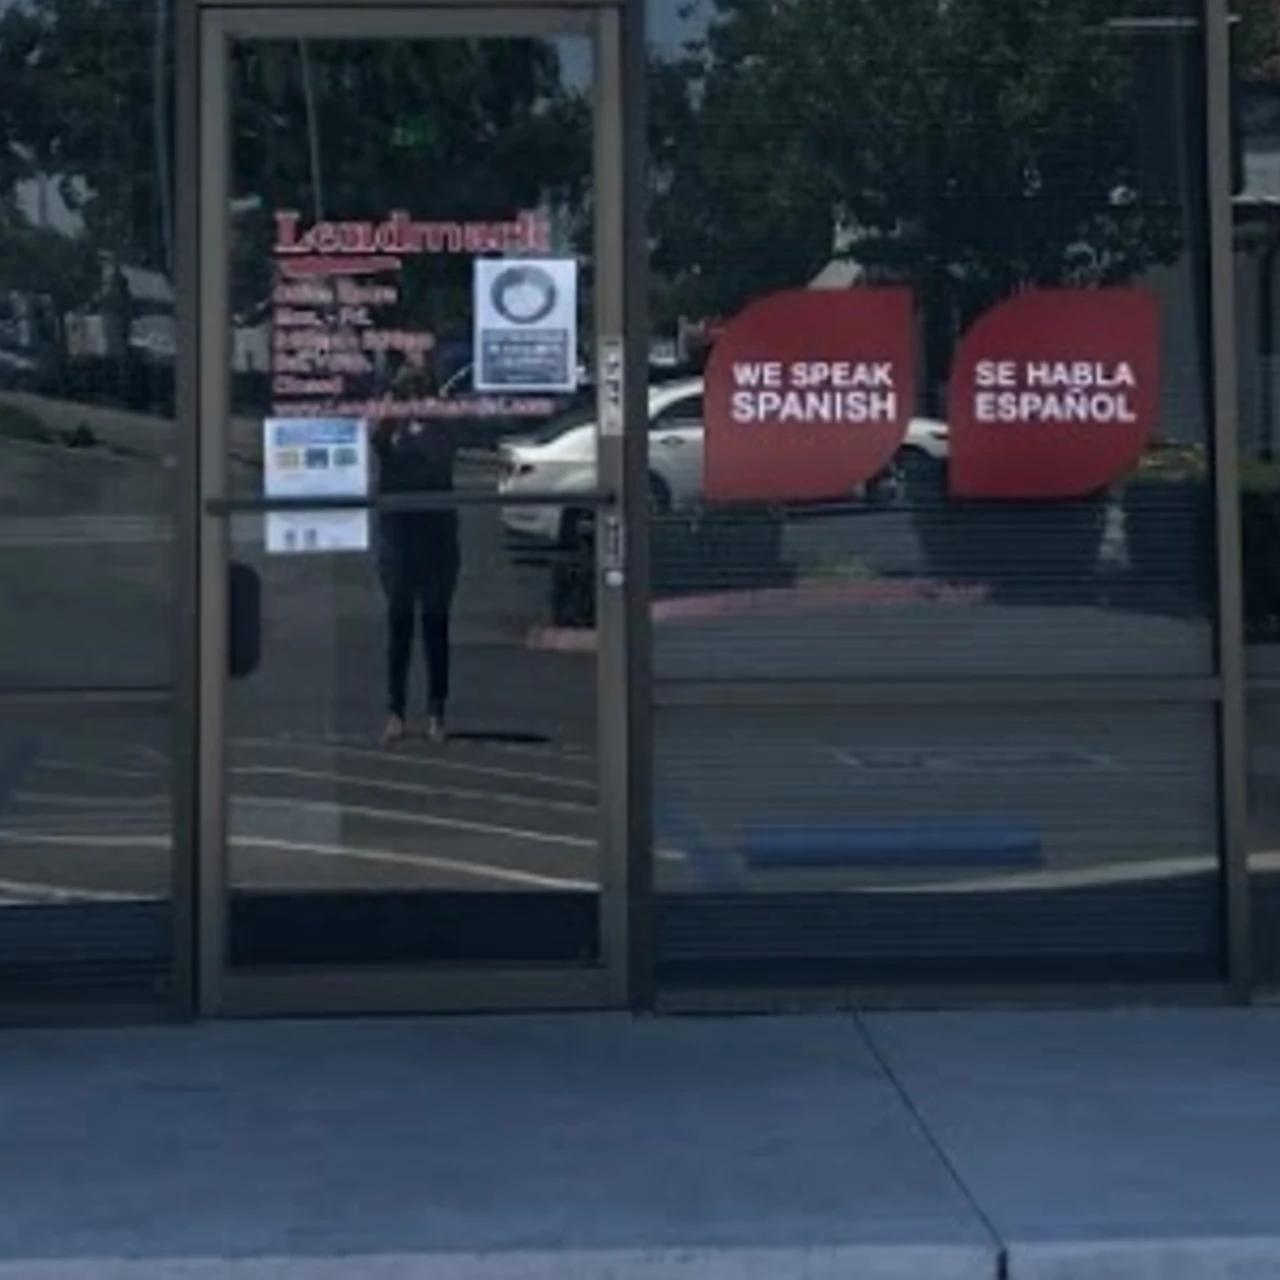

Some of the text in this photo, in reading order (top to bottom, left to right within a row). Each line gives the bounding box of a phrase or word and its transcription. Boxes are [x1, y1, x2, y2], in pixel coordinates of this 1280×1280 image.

[273, 209, 550, 253] Lendmark
[733, 362, 893, 387] WE SPEAK
[975, 361, 1135, 386] SE HABLA
[732, 392, 896, 421] SPANISH
[975, 388, 1137, 421] ESPAÑOL
